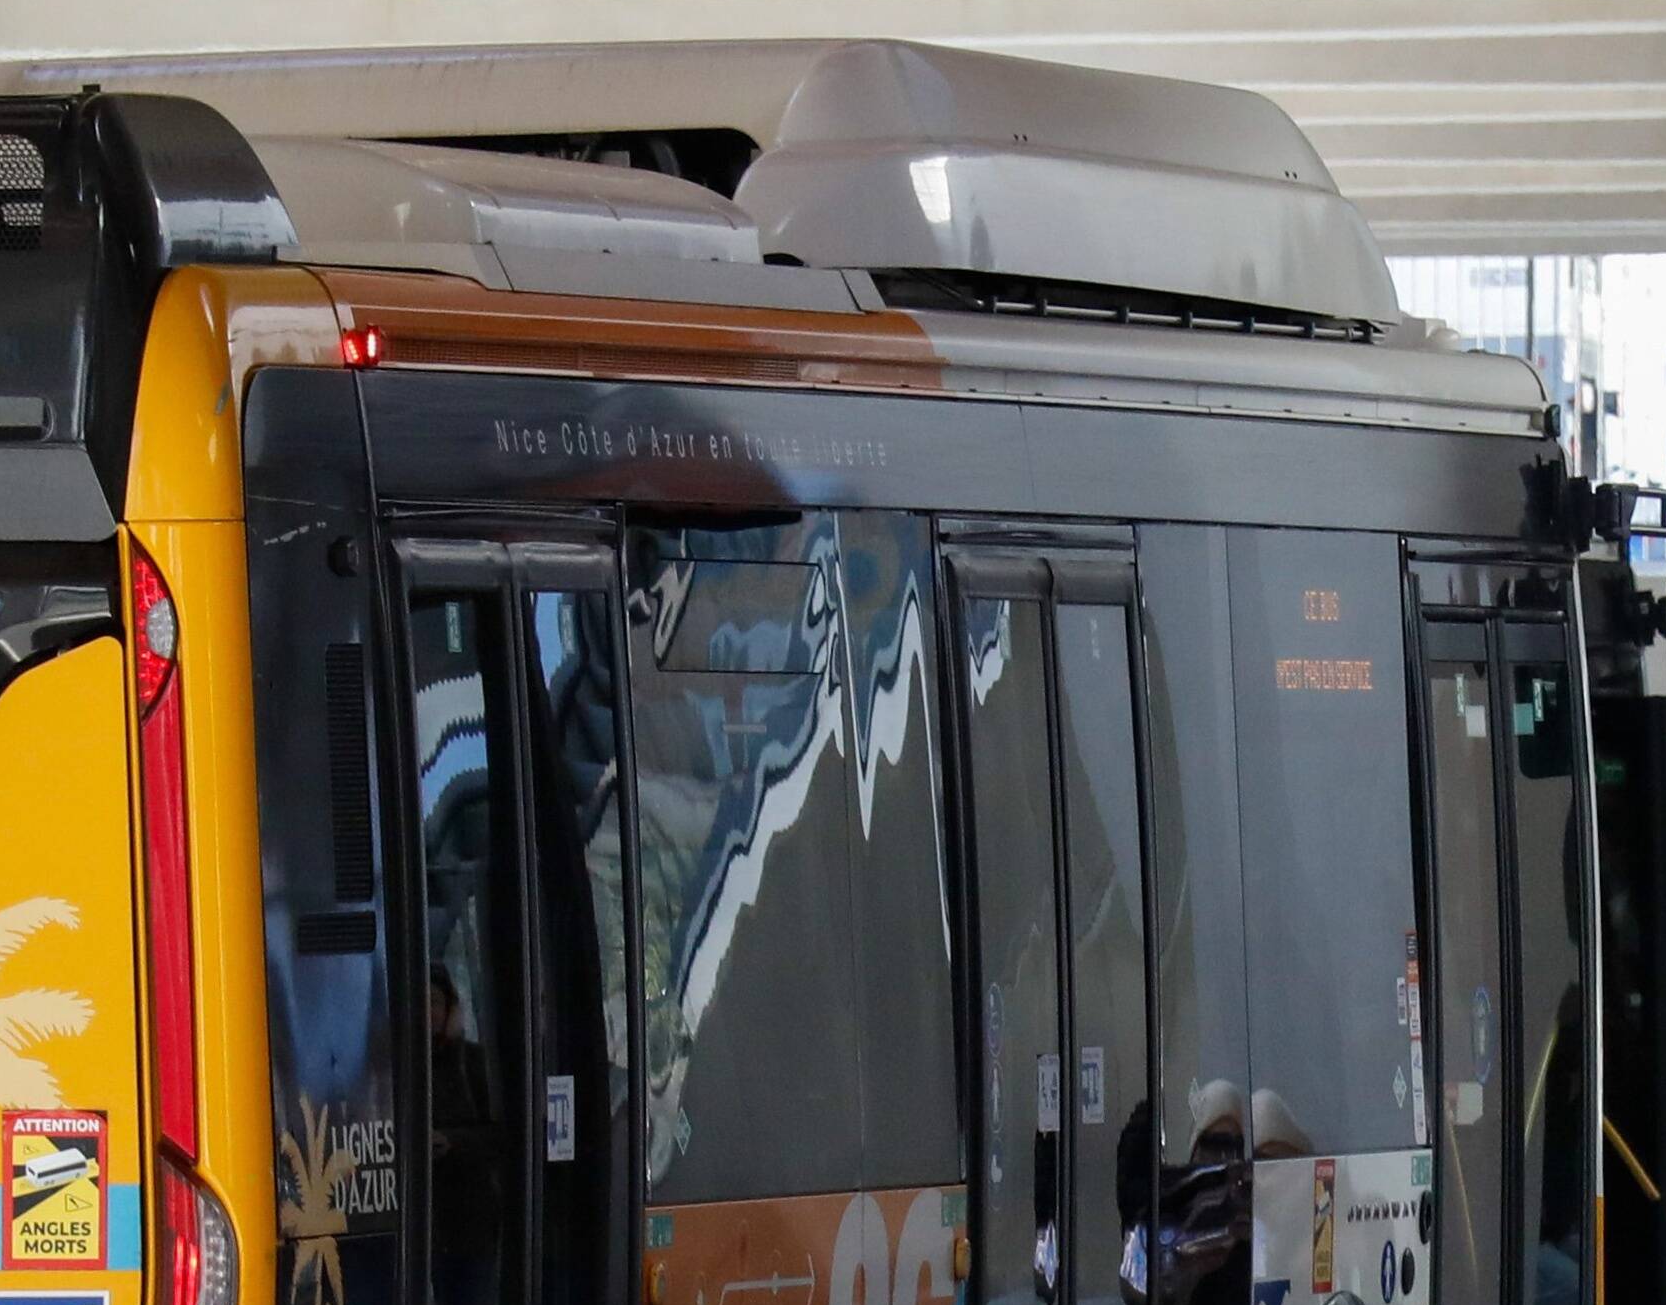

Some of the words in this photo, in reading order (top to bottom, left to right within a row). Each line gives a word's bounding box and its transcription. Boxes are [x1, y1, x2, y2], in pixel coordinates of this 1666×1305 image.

[493, 419, 547, 455] Nice
[560, 422, 612, 456] Côte
[627, 426, 695, 459] d'Azur
[709, 434, 732, 460] en
[14, 1118, 100, 1133] ATTENTION
[20, 1221, 91, 1236] ANGLES
[24, 1238, 87, 1254] MORTS
